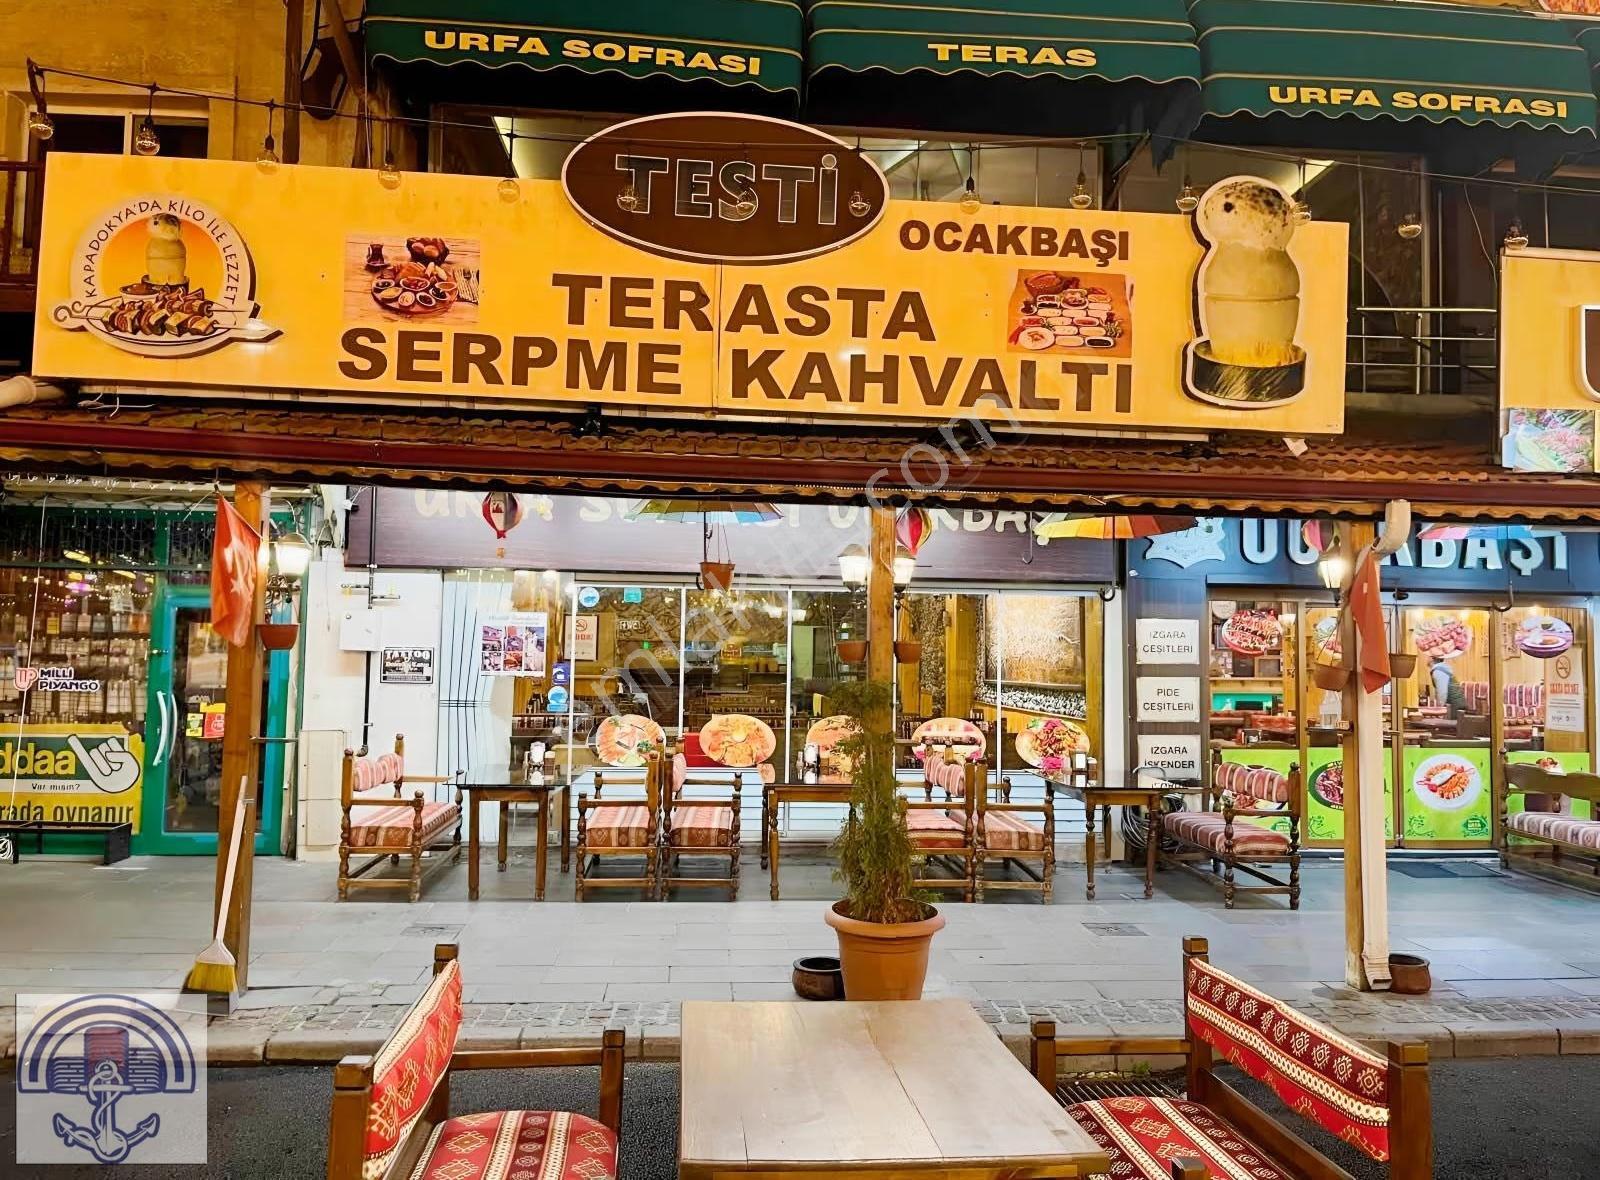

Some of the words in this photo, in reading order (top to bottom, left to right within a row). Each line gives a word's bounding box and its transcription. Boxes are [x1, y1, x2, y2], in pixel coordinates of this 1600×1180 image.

[424, 30, 550, 56] URFA
[561, 39, 761, 75] SOFRASI
[928, 43, 1097, 67] TERAS
[1269, 86, 1382, 107] URFA
[1391, 91, 1568, 118] SOFRASI
[615, 153, 838, 225] TESTİ
[83, 200, 162, 298] KAPADOKYA'DA
[222, 244, 240, 305] LEZZET
[899, 220, 1129, 267] OCAKBAŞI
[552, 273, 936, 342] TERASTA
[338, 327, 682, 395] SERPME
[731, 348, 1133, 413] KAHVALTI
[1151, 746, 1188, 754] IZGARA
